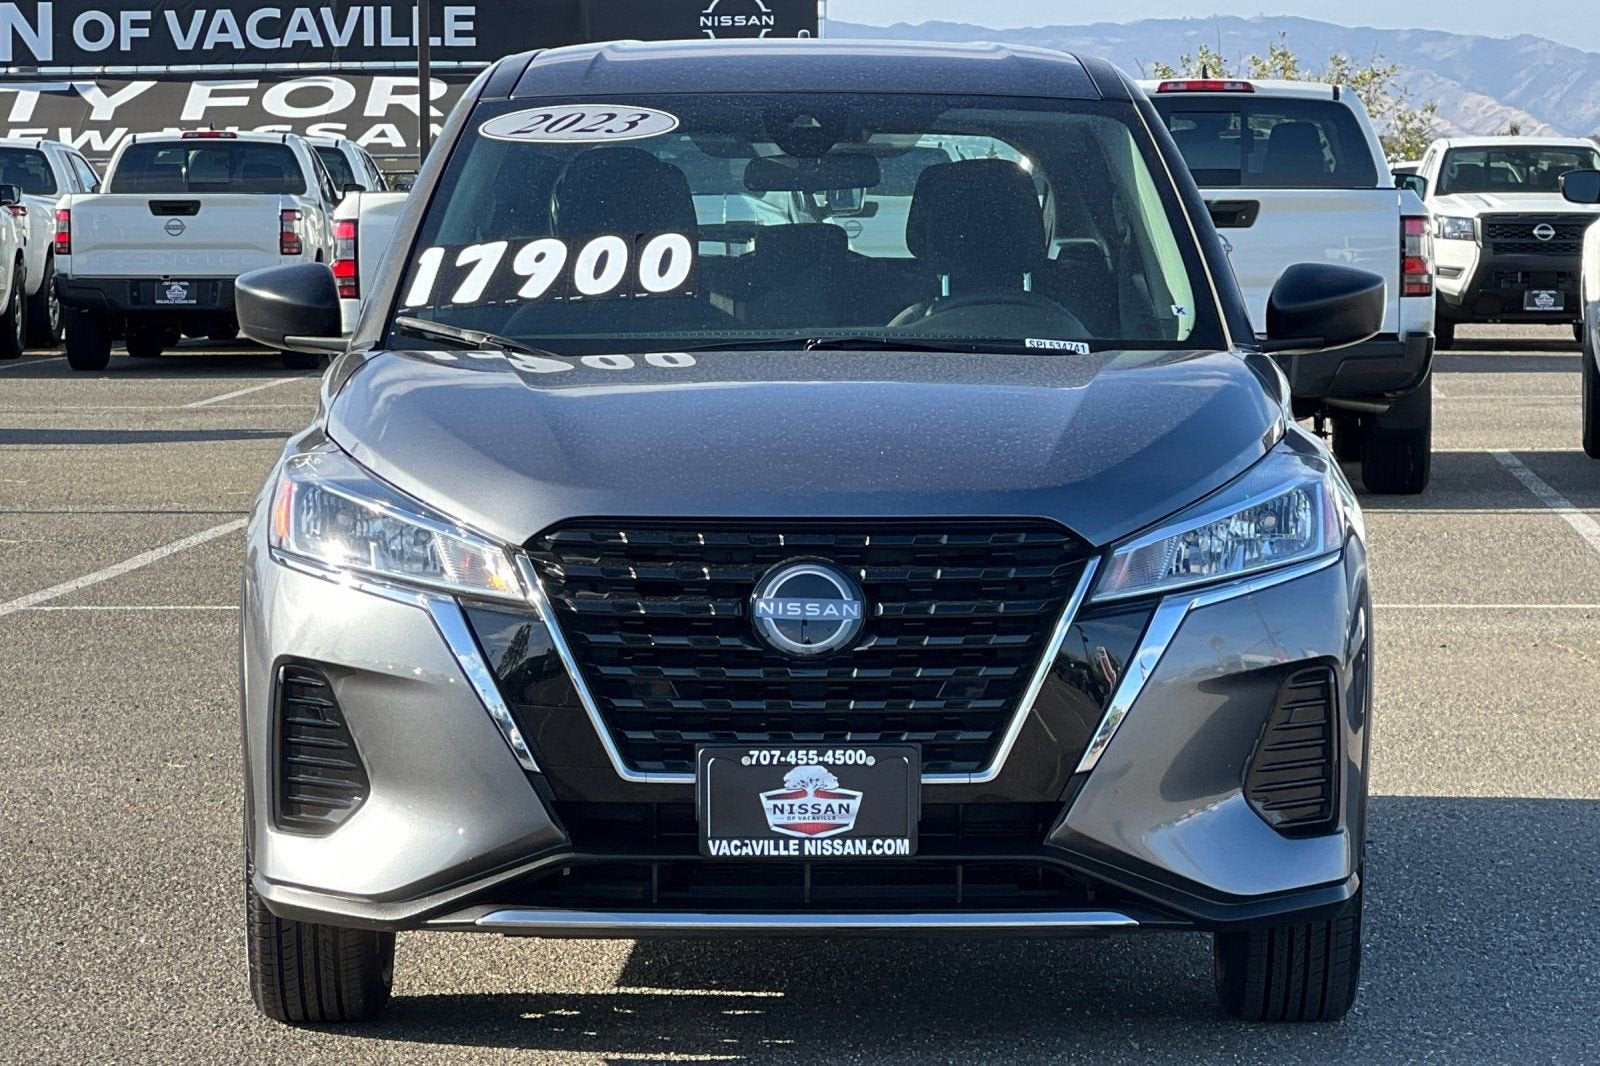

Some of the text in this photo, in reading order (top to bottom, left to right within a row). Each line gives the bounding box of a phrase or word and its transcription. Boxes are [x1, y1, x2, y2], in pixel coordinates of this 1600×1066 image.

[73, 10, 151, 52] OF
[165, 6, 476, 50] VACAVILLE
[700, 15, 774, 26] NISSAN
[180, 76, 449, 120] FOR
[508, 112, 650, 135] 2023
[404, 232, 693, 307] 17900
[758, 601, 859, 617] NISSAN
[749, 750, 867, 765] 707-455-4500
[772, 803, 850, 815] NISSAN
[708, 838, 911, 855] VACAVILLE NISSAN.COM
